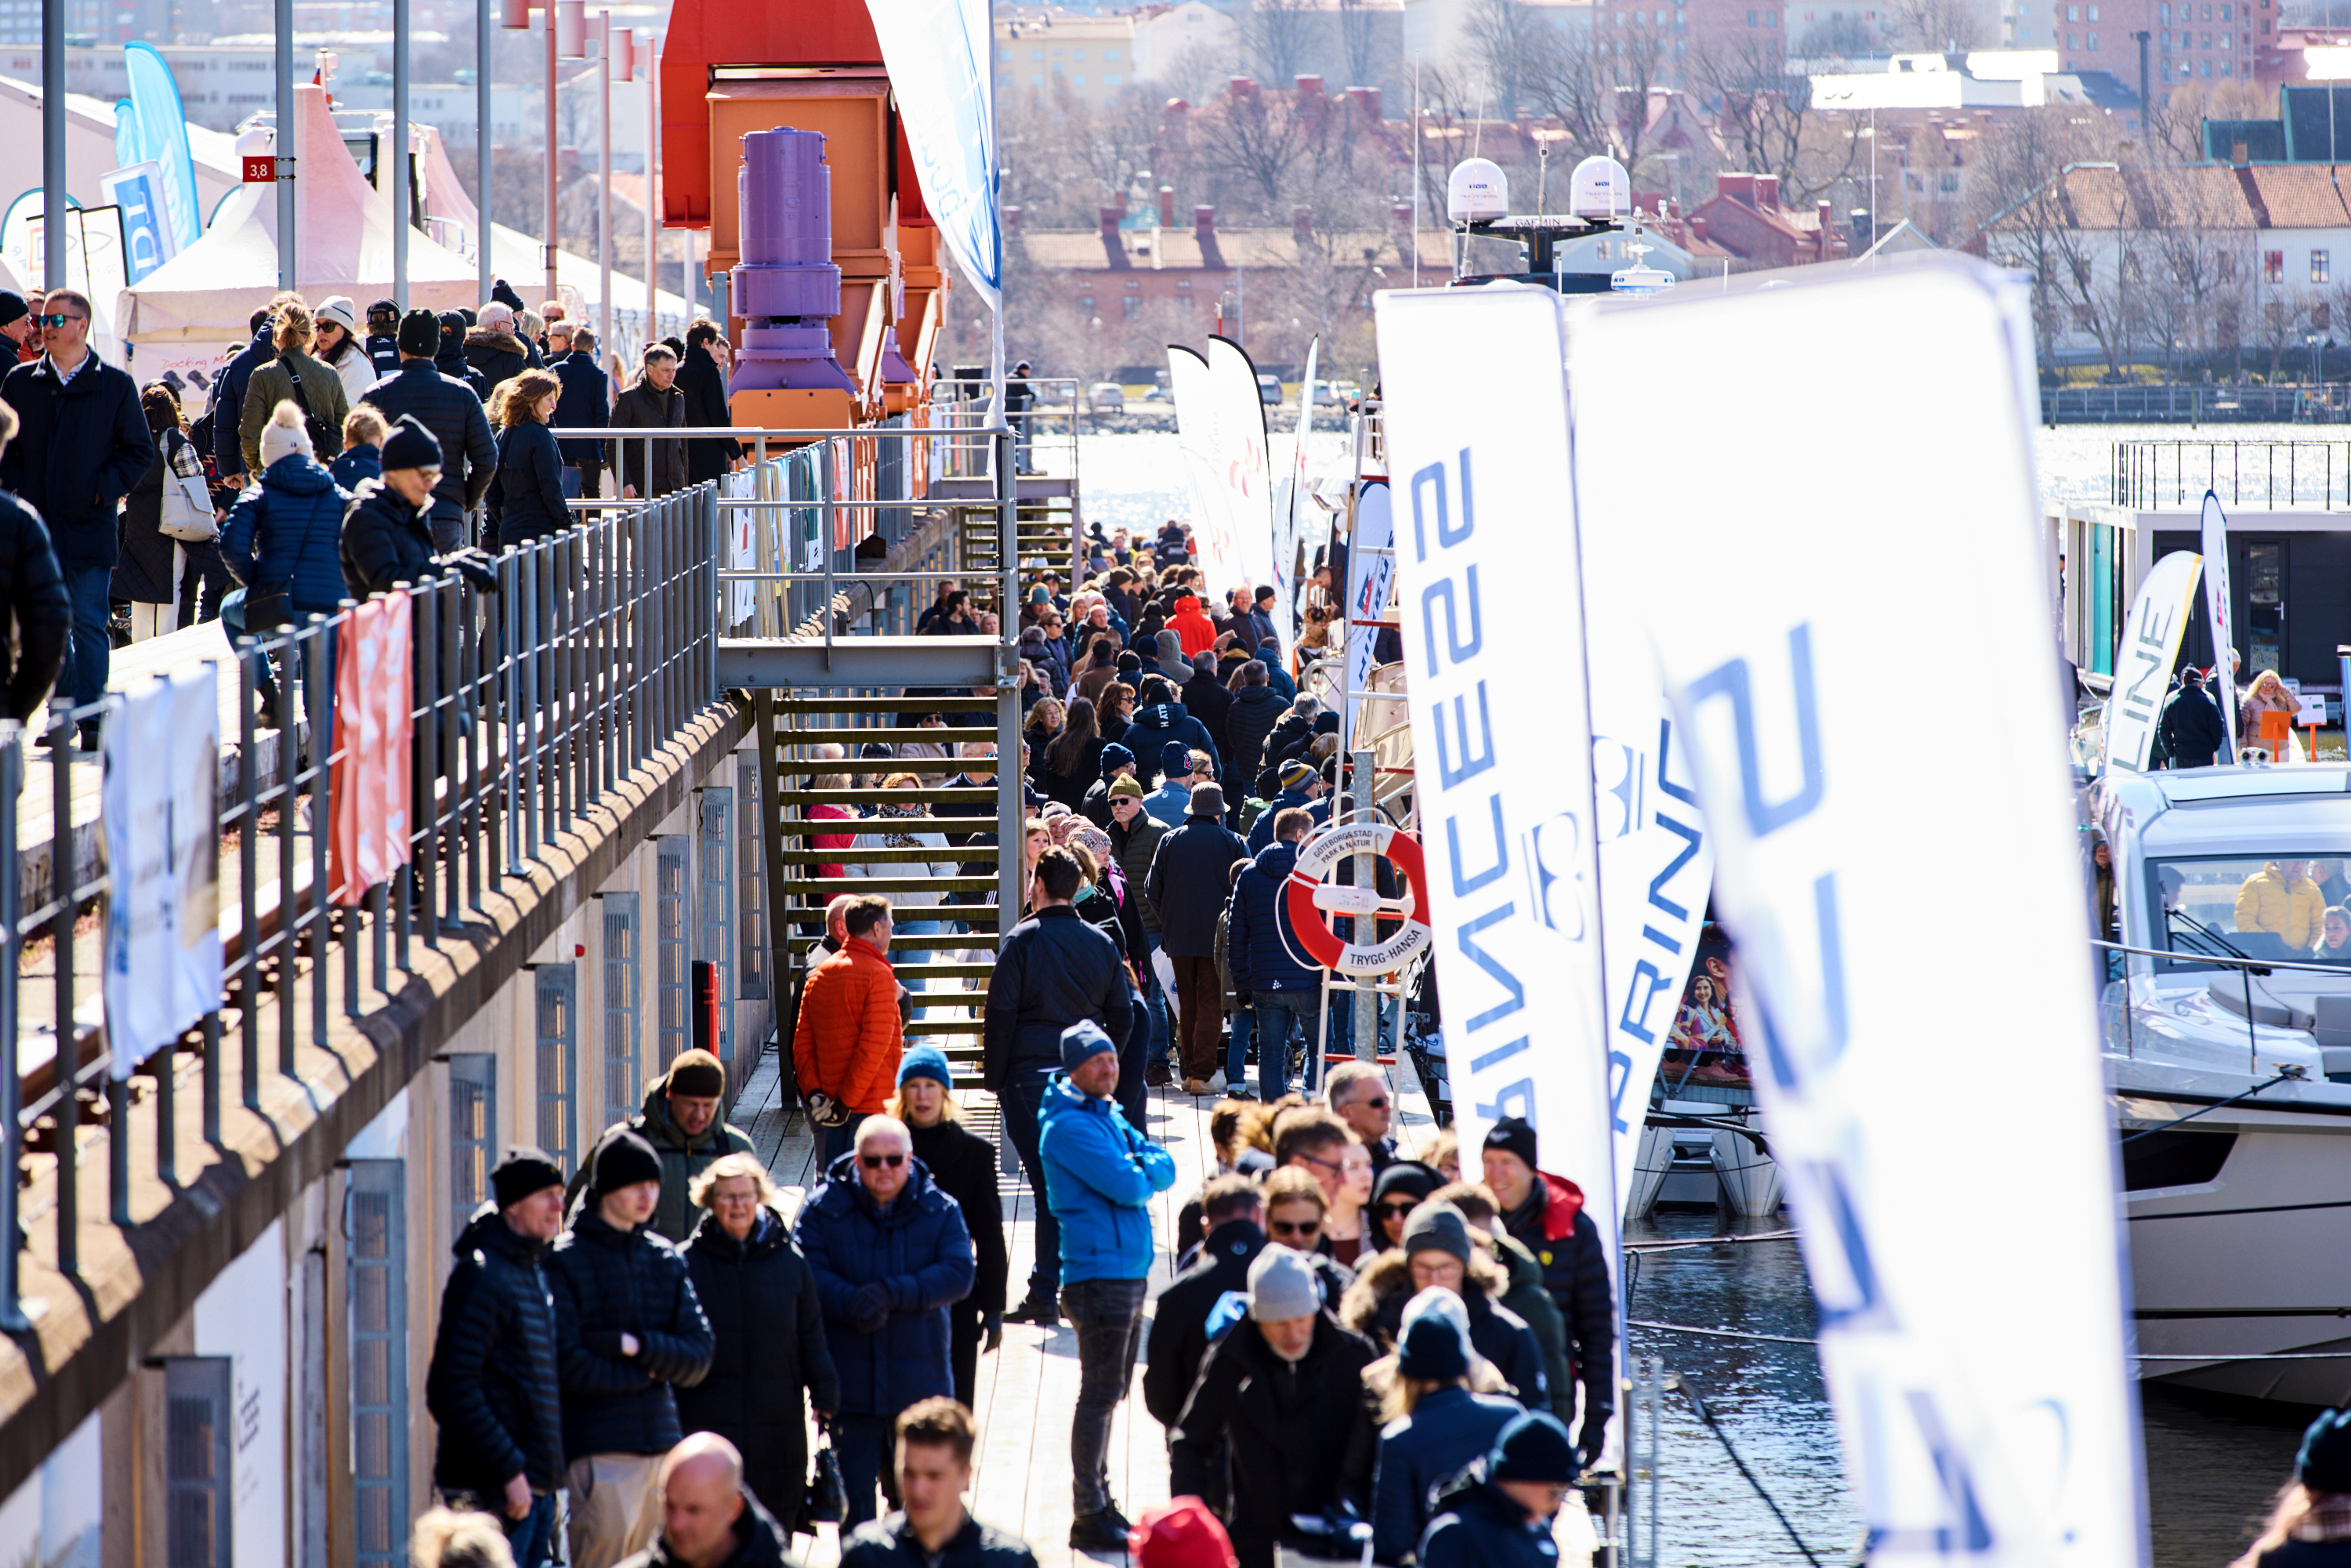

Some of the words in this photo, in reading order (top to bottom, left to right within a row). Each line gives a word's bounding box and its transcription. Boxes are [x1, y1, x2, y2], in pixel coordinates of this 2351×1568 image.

[250, 164, 267, 179] 3,8
[161, 357, 208, 371] Docking
[2112, 596, 2174, 772] LINE
[1313, 832, 1353, 859] GÖTEBORGS
[1321, 847, 1339, 864] PARK
[1339, 843, 1346, 852] &
[1346, 839, 1371, 849] NATUR
[1350, 929, 1422, 966] TRYGG-HANSA
